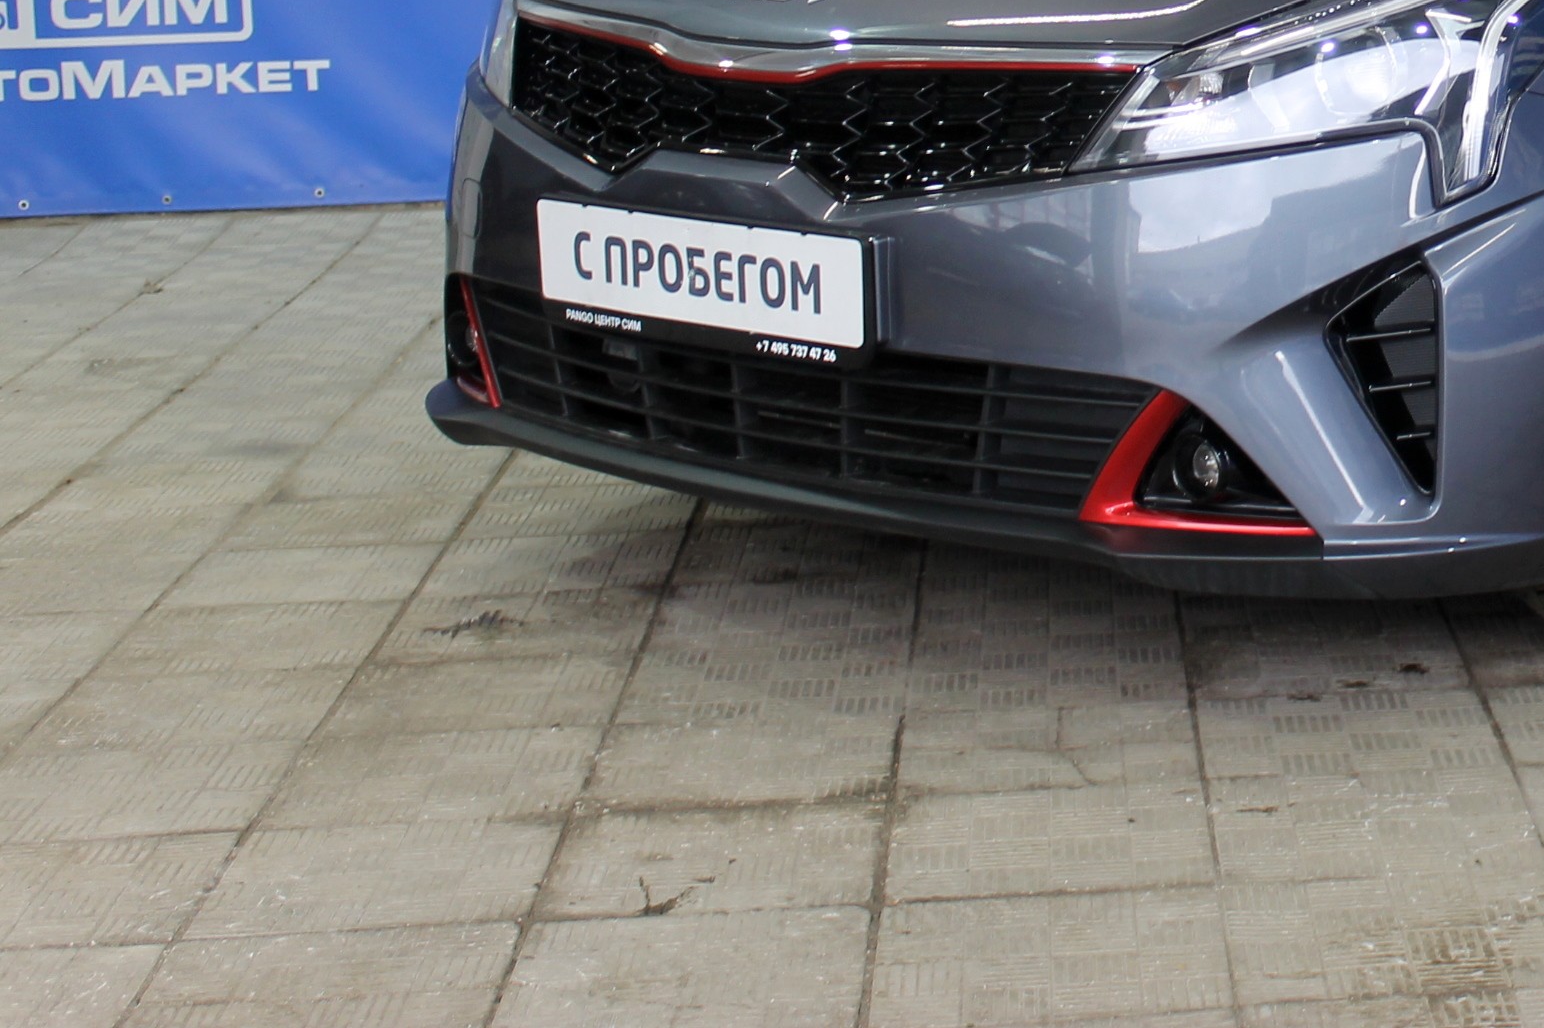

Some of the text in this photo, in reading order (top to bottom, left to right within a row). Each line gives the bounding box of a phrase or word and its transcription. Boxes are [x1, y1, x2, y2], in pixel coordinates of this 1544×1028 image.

[573, 230, 822, 315] С ПРОБЕГОМ
[565, 308, 642, 332] PANGO ЦЕНТР СИМ
[769, 341, 789, 356] 495
[790, 344, 808, 359] 737
